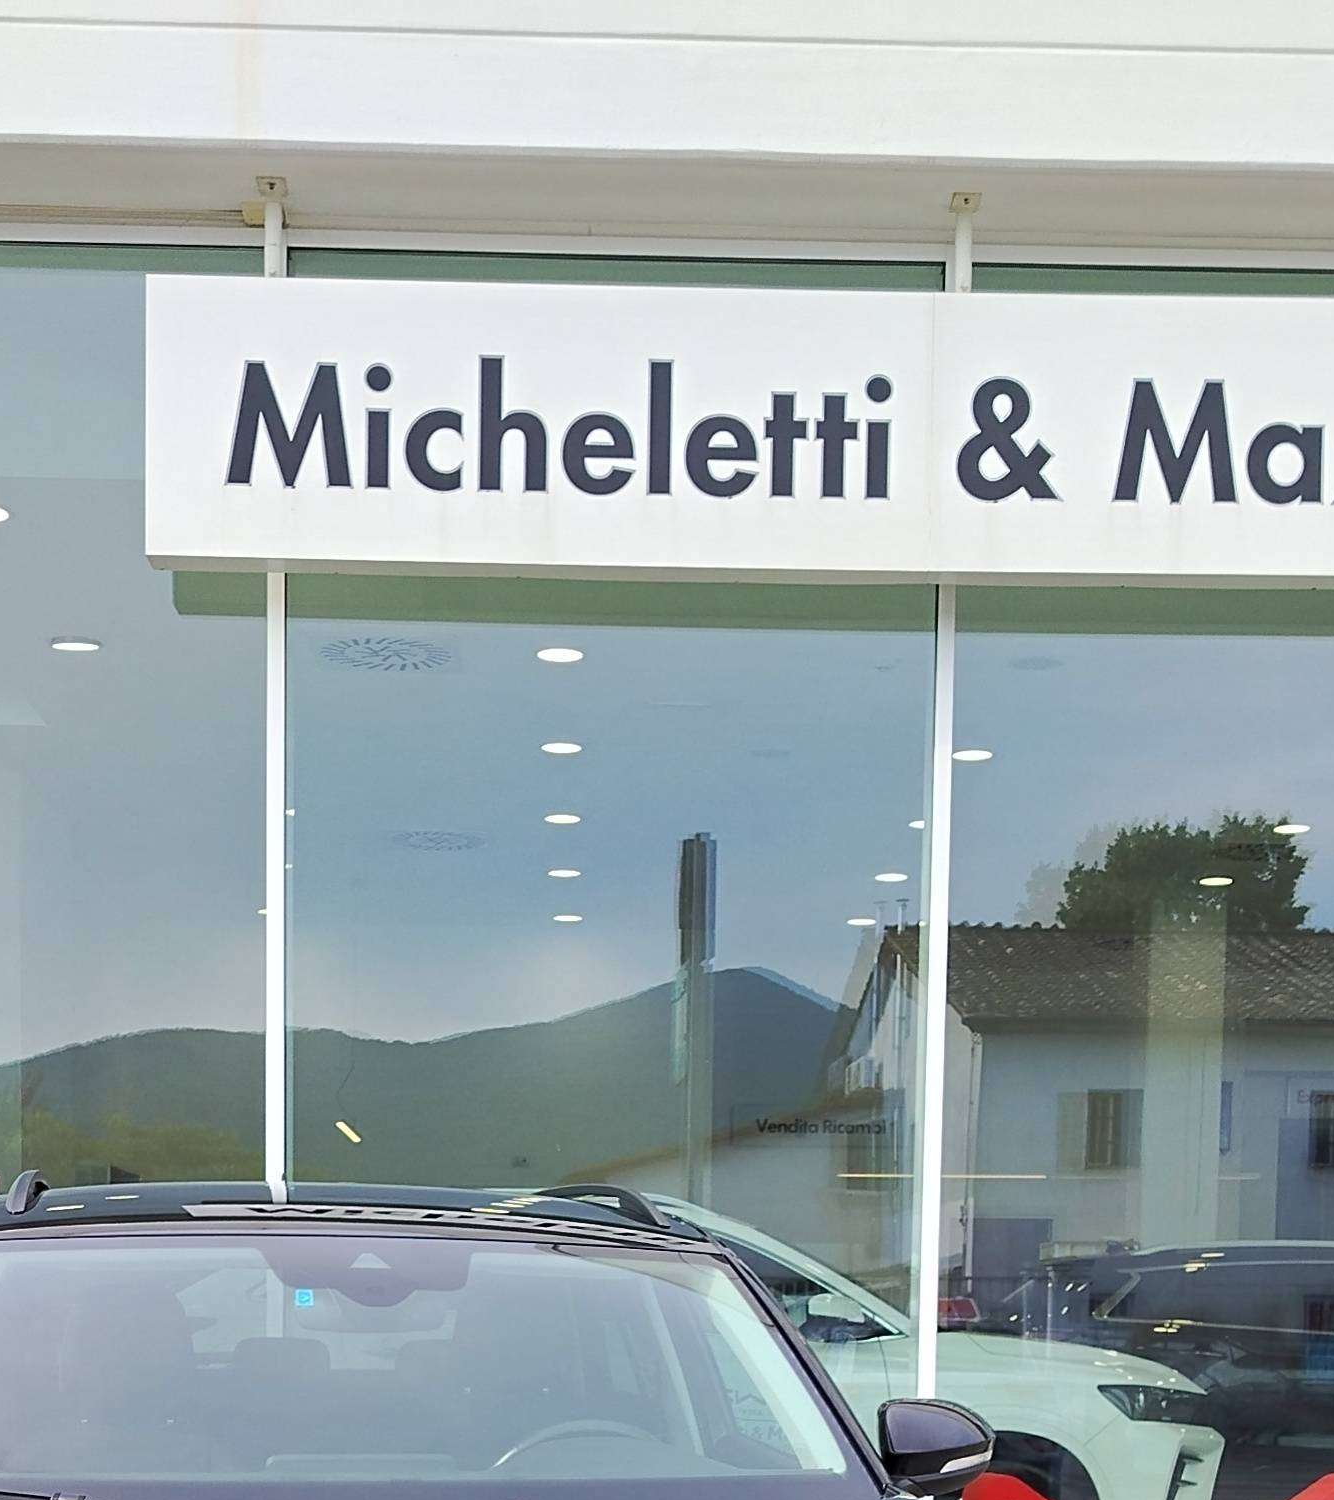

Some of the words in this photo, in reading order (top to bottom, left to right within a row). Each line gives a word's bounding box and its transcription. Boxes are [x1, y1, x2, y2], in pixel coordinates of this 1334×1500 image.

[224, 356, 893, 500] Micheletti
[956, 377, 1062, 505] &
[756, 1117, 818, 1134] Vendita
[822, 1118, 887, 1135] Ricambi
